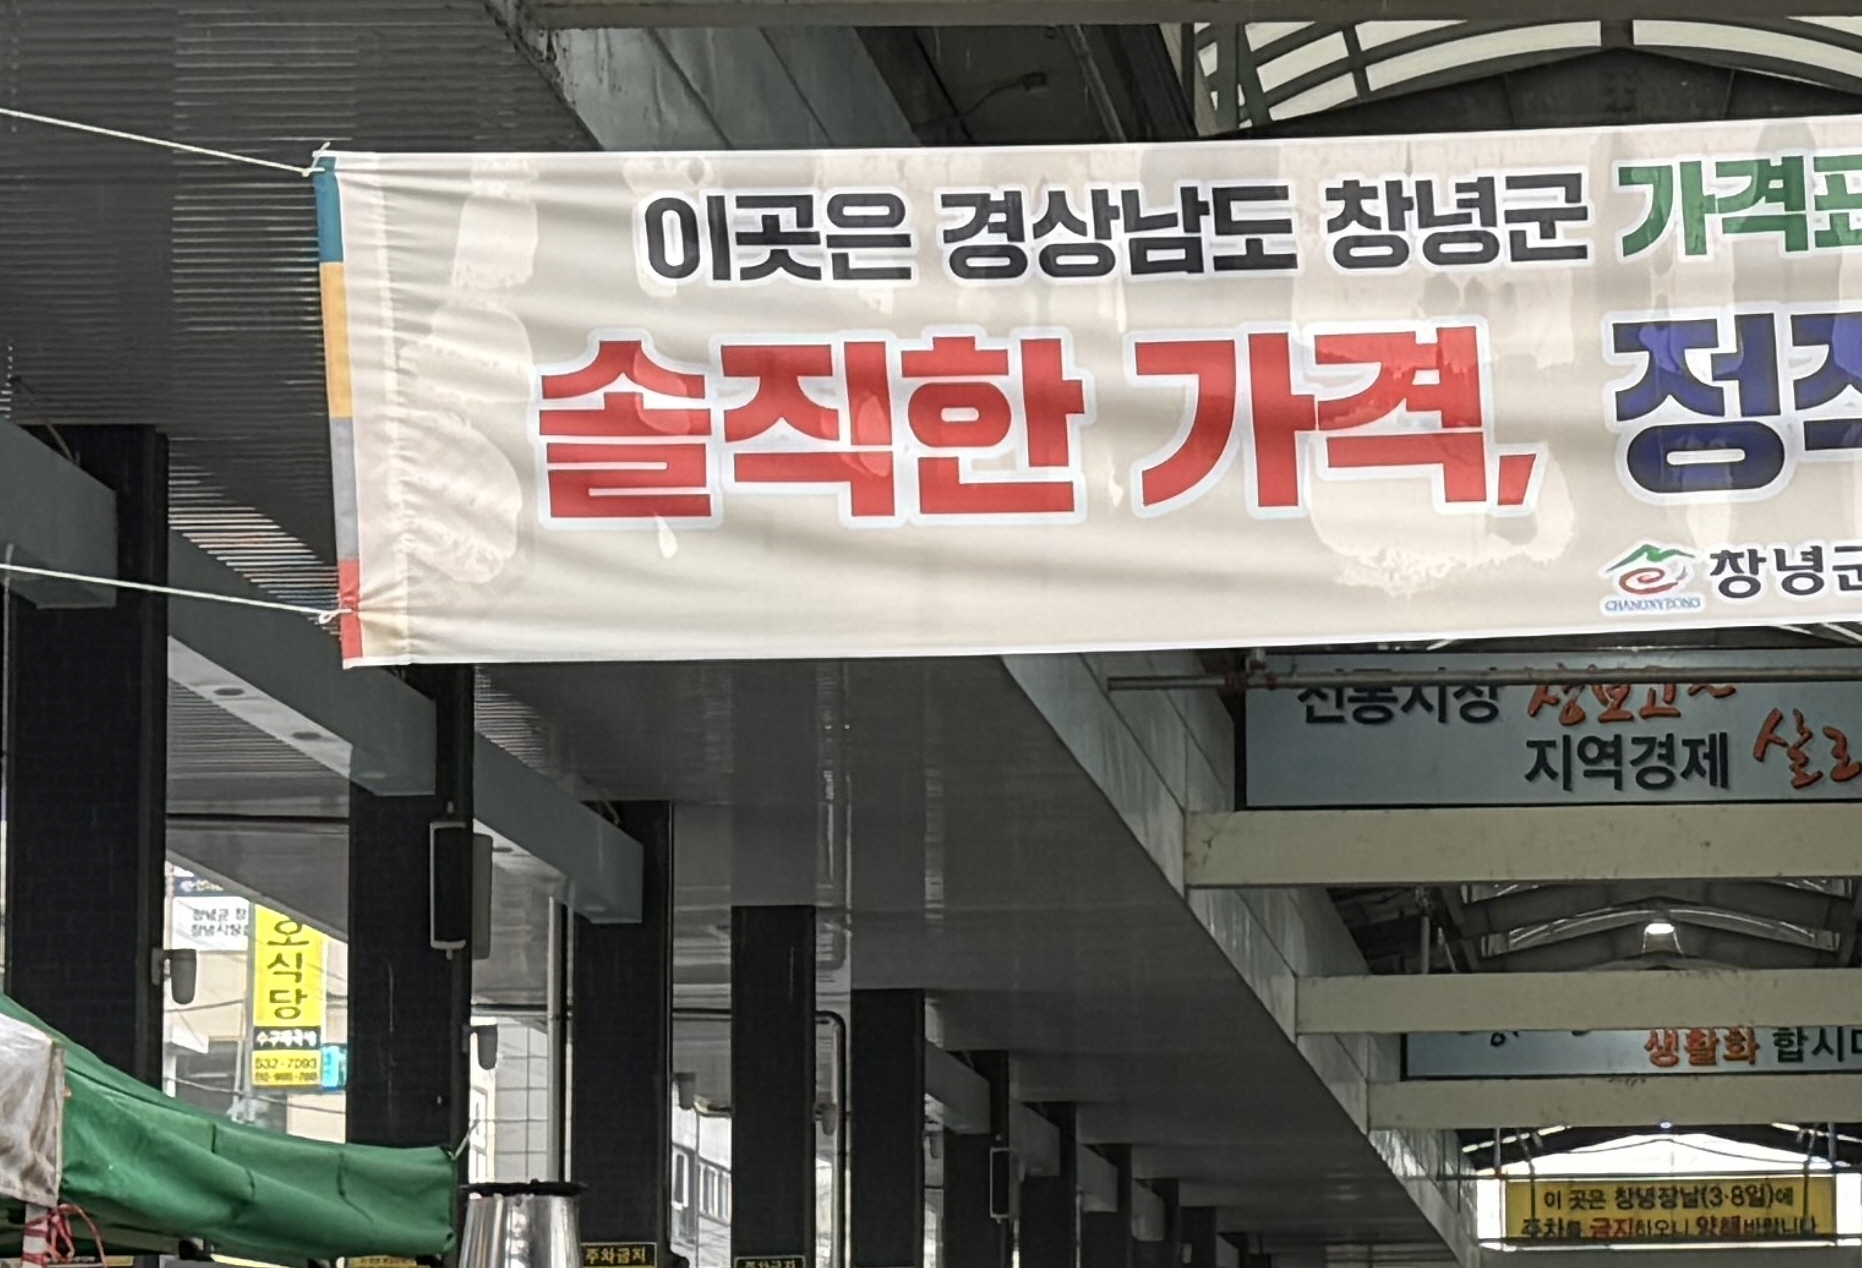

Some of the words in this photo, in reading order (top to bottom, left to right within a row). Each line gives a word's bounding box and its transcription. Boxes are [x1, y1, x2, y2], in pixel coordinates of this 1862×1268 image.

[645, 191, 912, 281] 이곳은
[941, 184, 1298, 278] 경상남도
[1326, 171, 1589, 269] 창녕군
[540, 336, 1084, 519] 솔직한
[1134, 325, 1537, 508] 가격,
[1525, 731, 1731, 791] 지역경제
[585, 1246, 647, 1264] 주차금지
